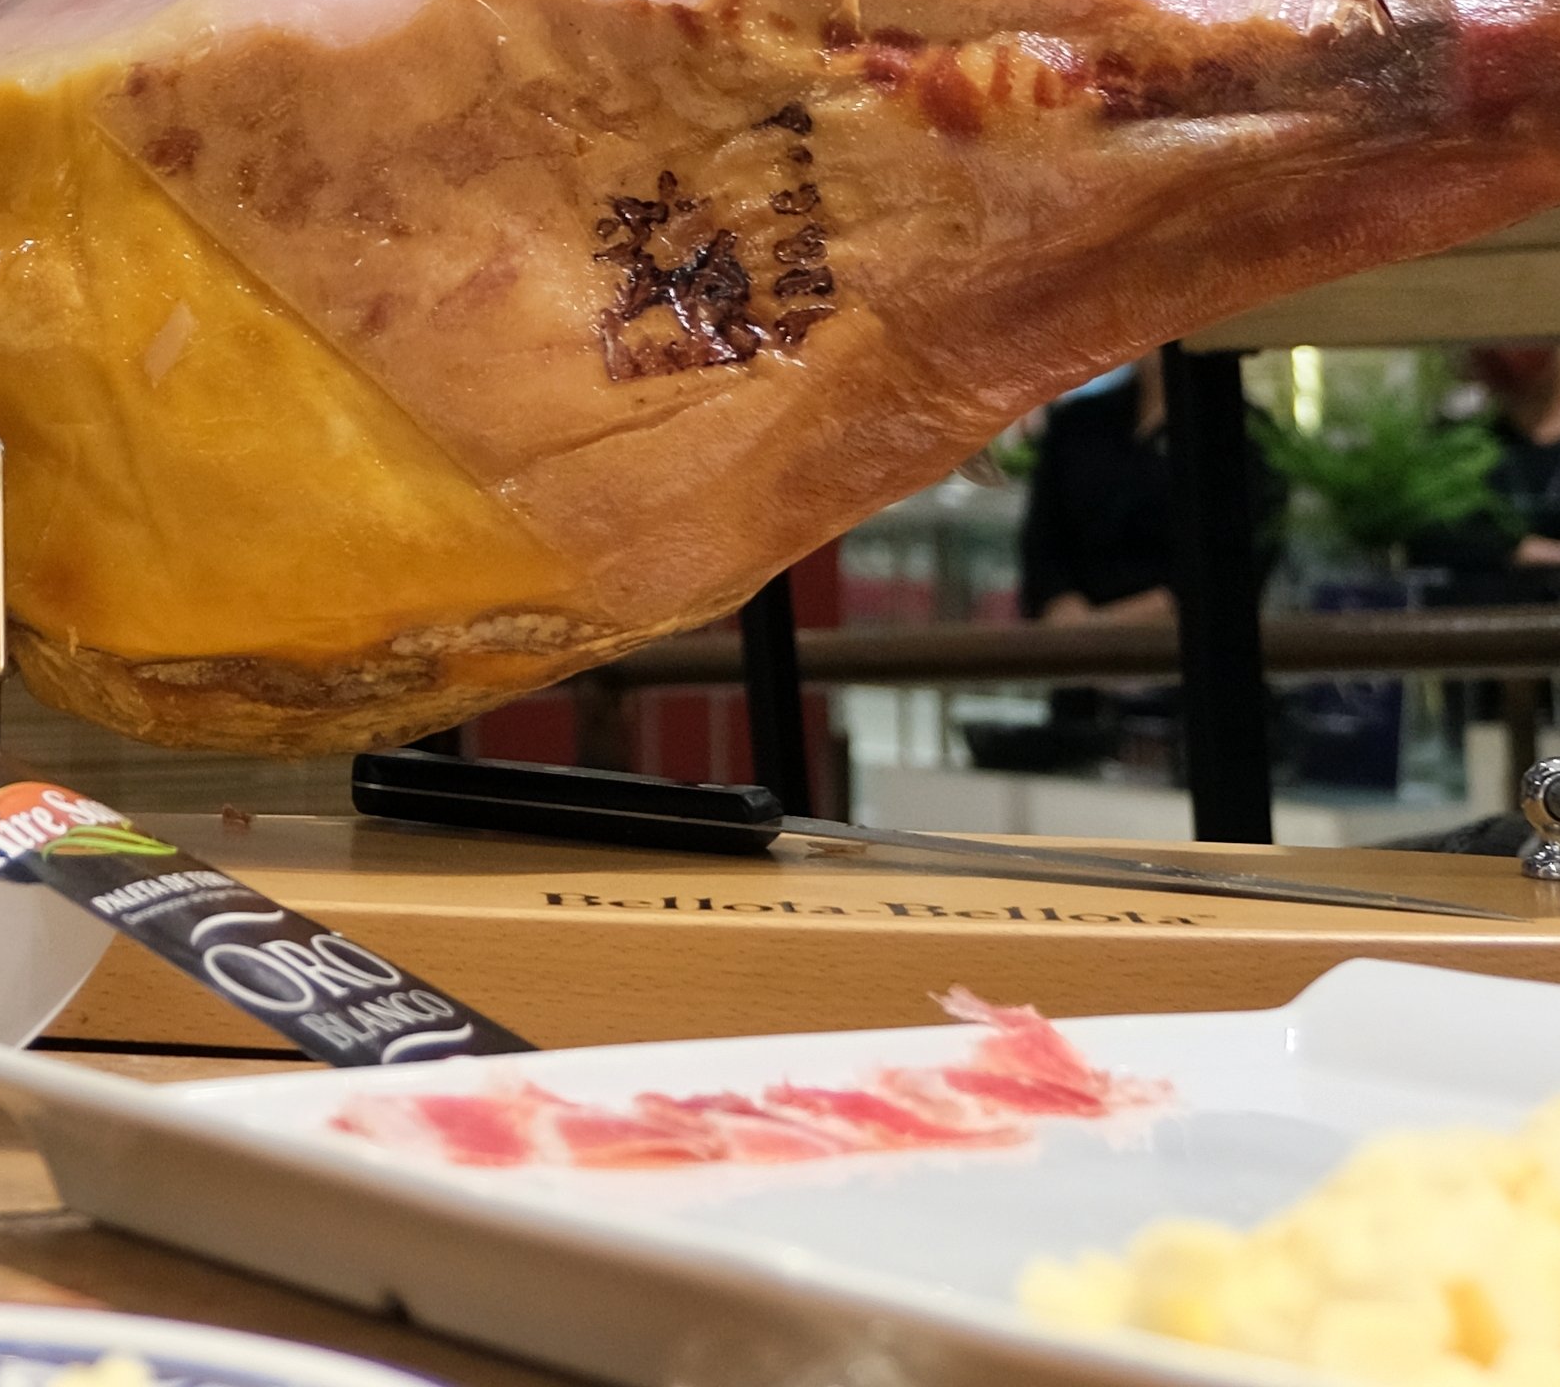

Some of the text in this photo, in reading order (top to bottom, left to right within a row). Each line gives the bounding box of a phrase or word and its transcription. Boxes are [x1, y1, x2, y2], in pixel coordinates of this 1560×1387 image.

[539, 890, 1204, 927] Bellota-Bellota
[202, 933, 402, 1012] ORO
[299, 988, 454, 1051] BLANCO
